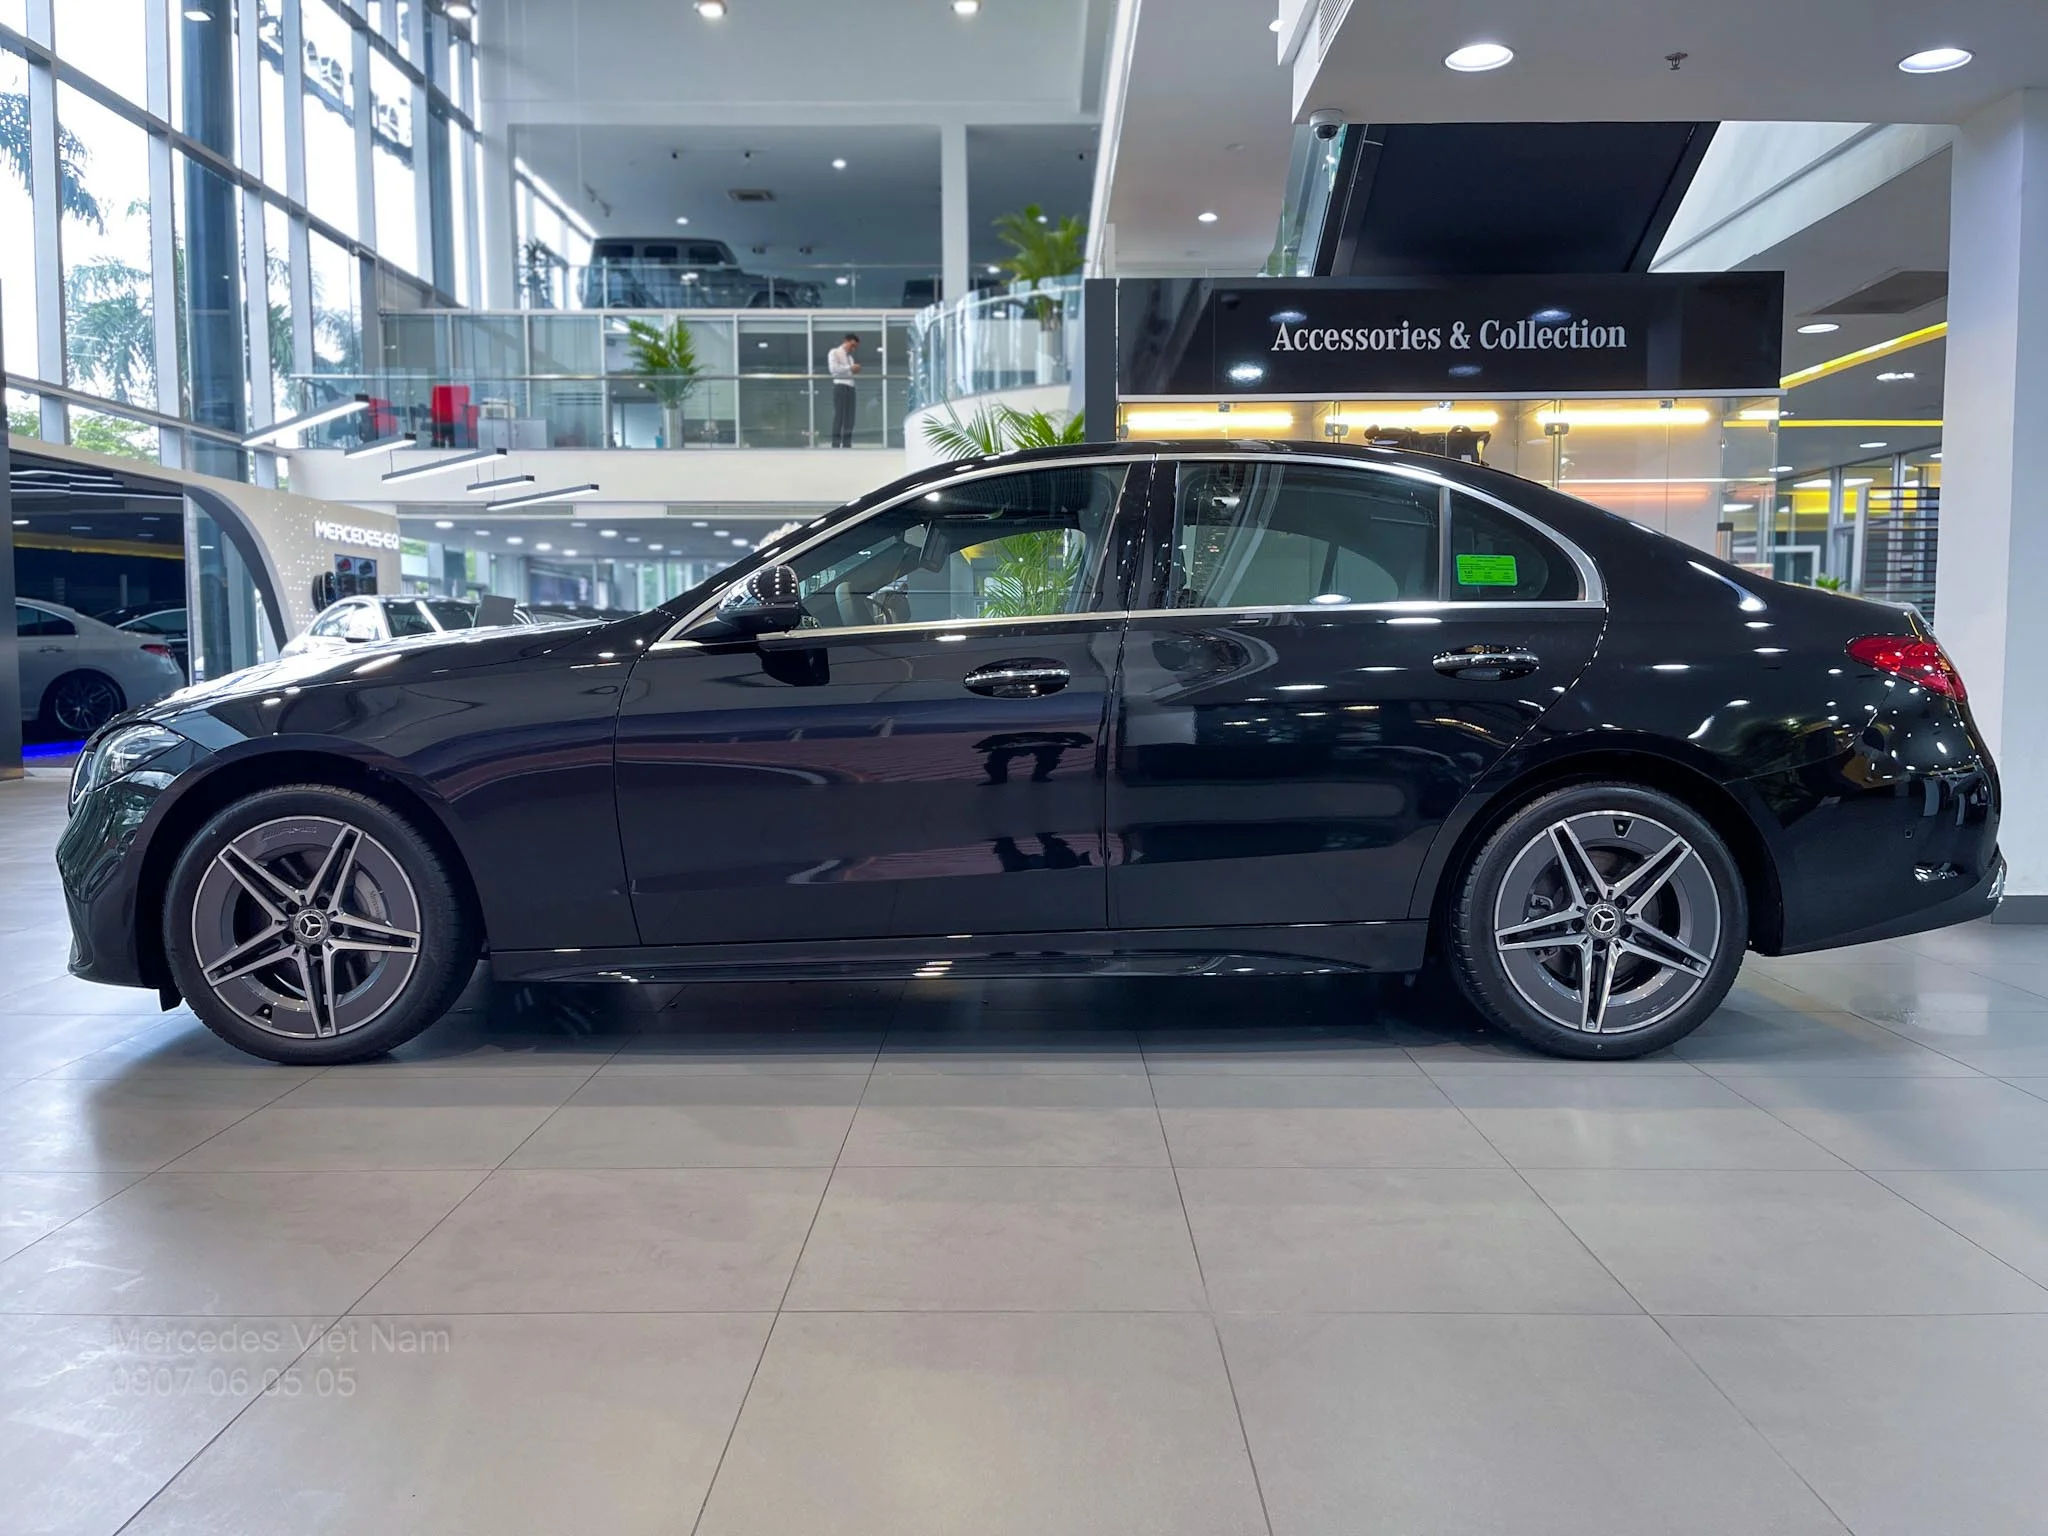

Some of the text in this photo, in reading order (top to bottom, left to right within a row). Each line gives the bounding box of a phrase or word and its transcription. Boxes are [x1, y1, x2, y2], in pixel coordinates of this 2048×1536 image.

[1271, 318, 1627, 352] Accessories & Collection
[314, 520, 400, 550] MERCEDES-EQ
